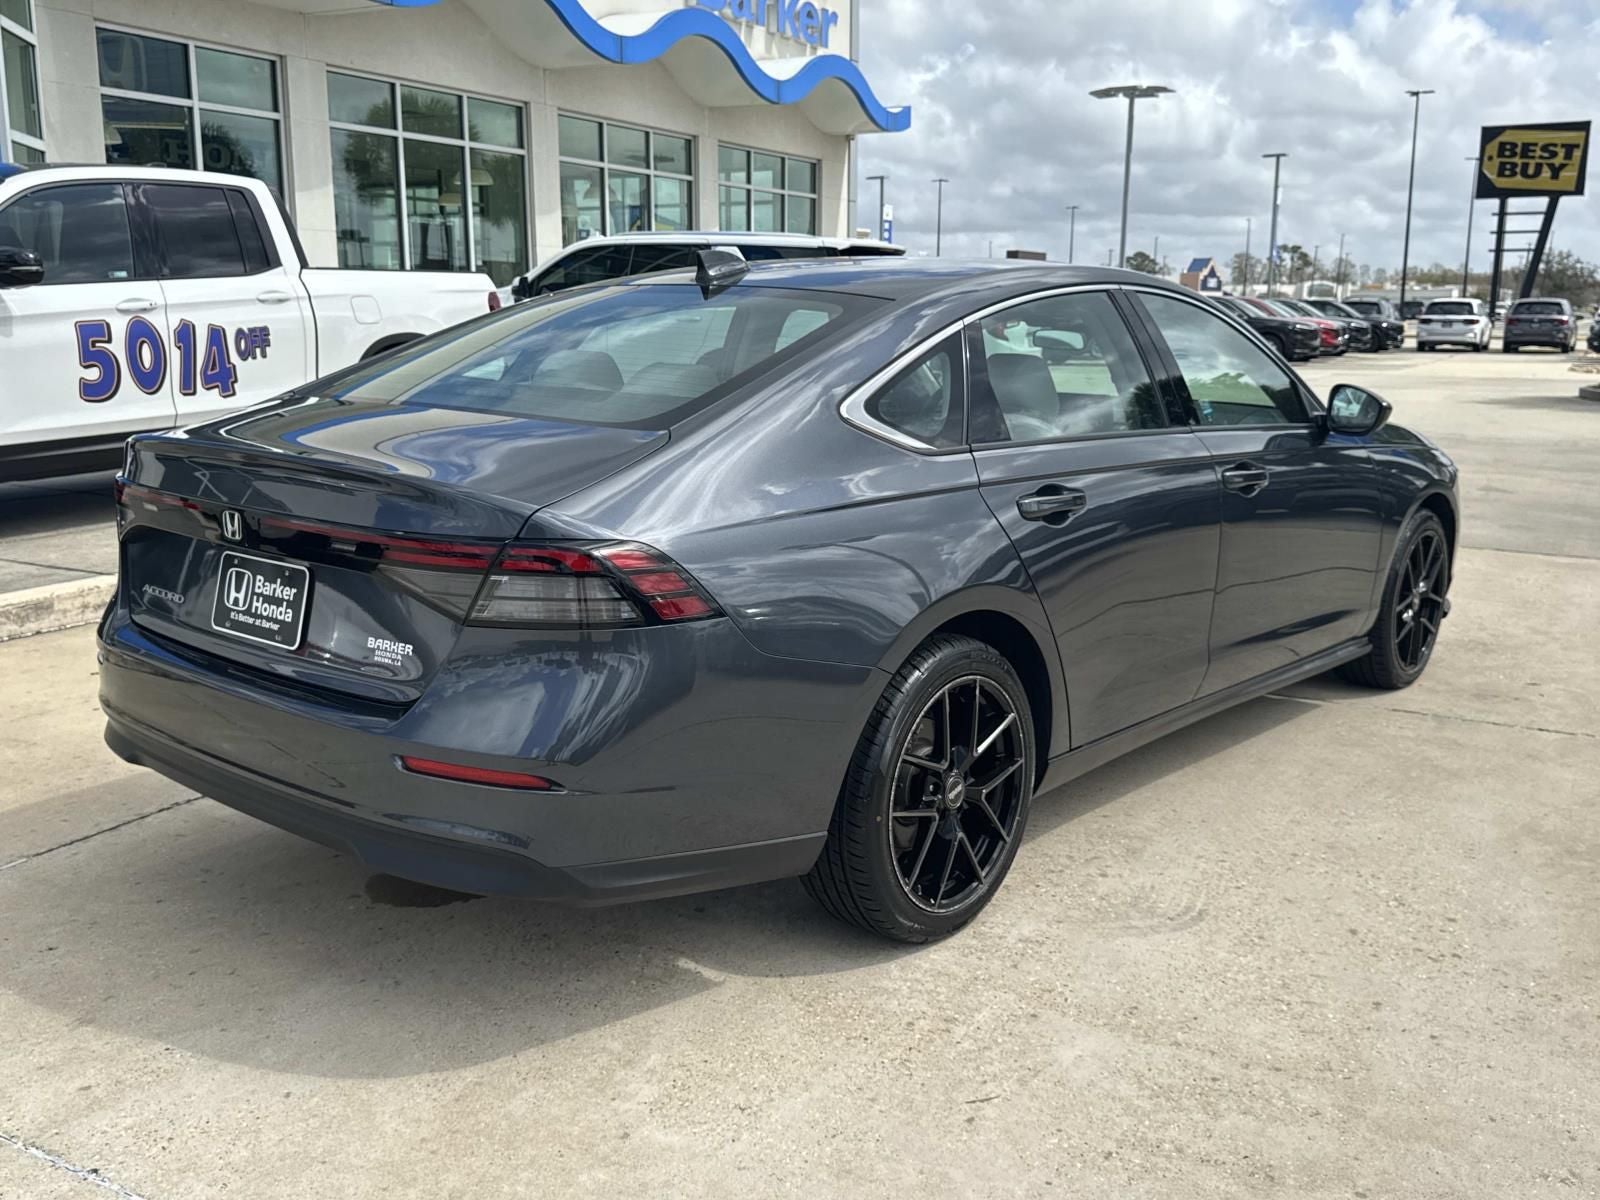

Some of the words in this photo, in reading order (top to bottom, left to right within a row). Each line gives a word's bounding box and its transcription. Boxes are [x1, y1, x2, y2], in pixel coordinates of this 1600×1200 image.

[1496, 141, 1581, 161] BEST
[1496, 161, 1569, 181] BUY
[75, 315, 238, 404] 5014
[234, 325, 271, 361] OFF
[142, 584, 185, 604] ACCORD
[254, 574, 297, 601] Barker
[251, 595, 293, 622] Honda
[367, 636, 413, 656] BARKER
[375, 650, 402, 660] HONDA
